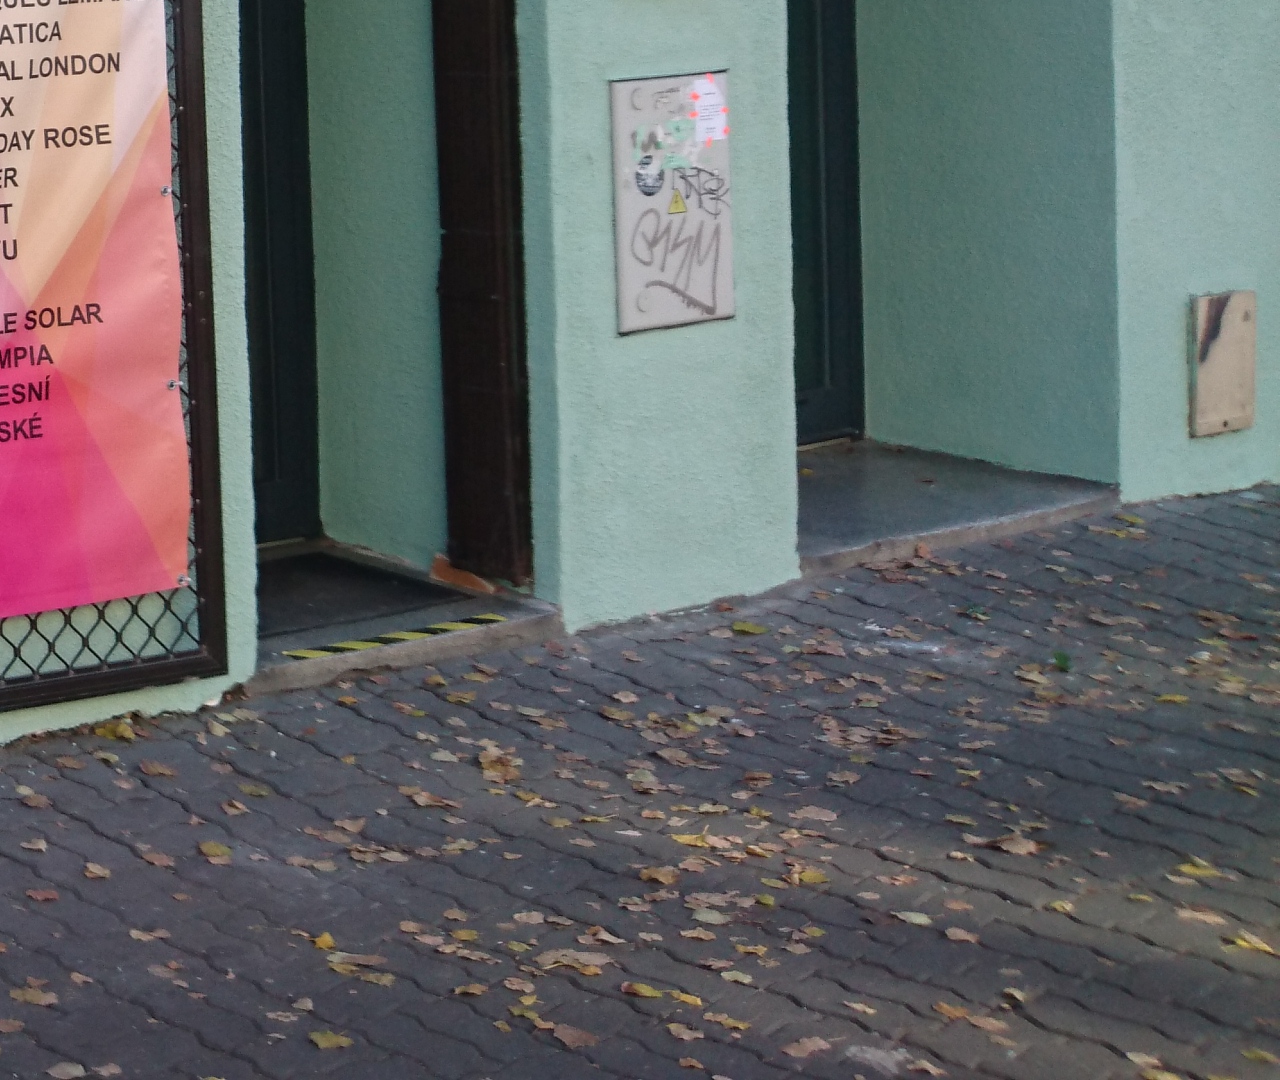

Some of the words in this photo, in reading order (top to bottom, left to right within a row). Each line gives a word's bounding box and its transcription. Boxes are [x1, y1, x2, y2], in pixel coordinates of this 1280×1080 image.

[28, 52, 122, 80] LONDON
[43, 124, 112, 150] ROSE
[24, 302, 104, 331] SOLAR
